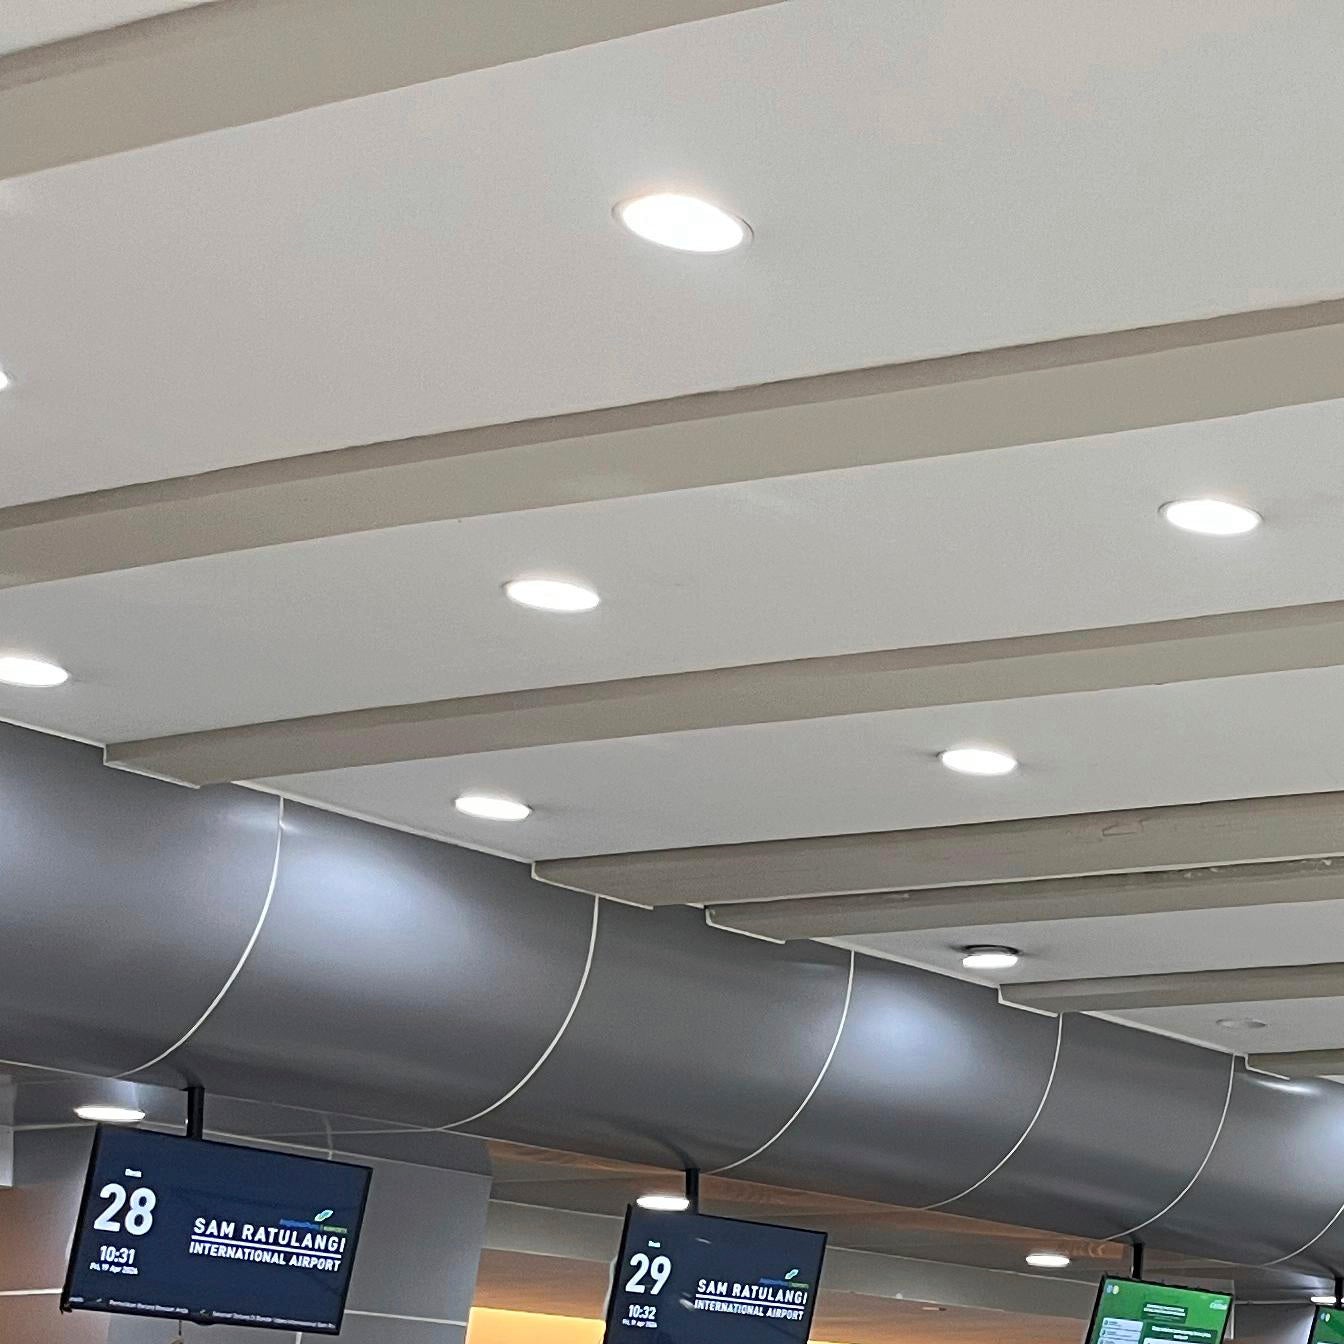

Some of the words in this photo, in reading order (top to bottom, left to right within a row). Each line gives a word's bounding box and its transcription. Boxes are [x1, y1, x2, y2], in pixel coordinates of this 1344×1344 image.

[94, 1183, 156, 1235] 28
[193, 1217, 235, 1238] SAM
[242, 1224, 347, 1253] RATULANGI
[100, 1245, 135, 1265] 10:31
[189, 1241, 287, 1266] INTERNATIONAL
[289, 1257, 341, 1272] AIRPORT
[625, 1253, 672, 1295] 29
[697, 1279, 728, 1296] SAM
[732, 1283, 808, 1305] RATULANGI
[628, 1304, 657, 1320] 10:32
[694, 1299, 765, 1317] INTERNATIONAL
[766, 1307, 804, 1320] AIRPORT
